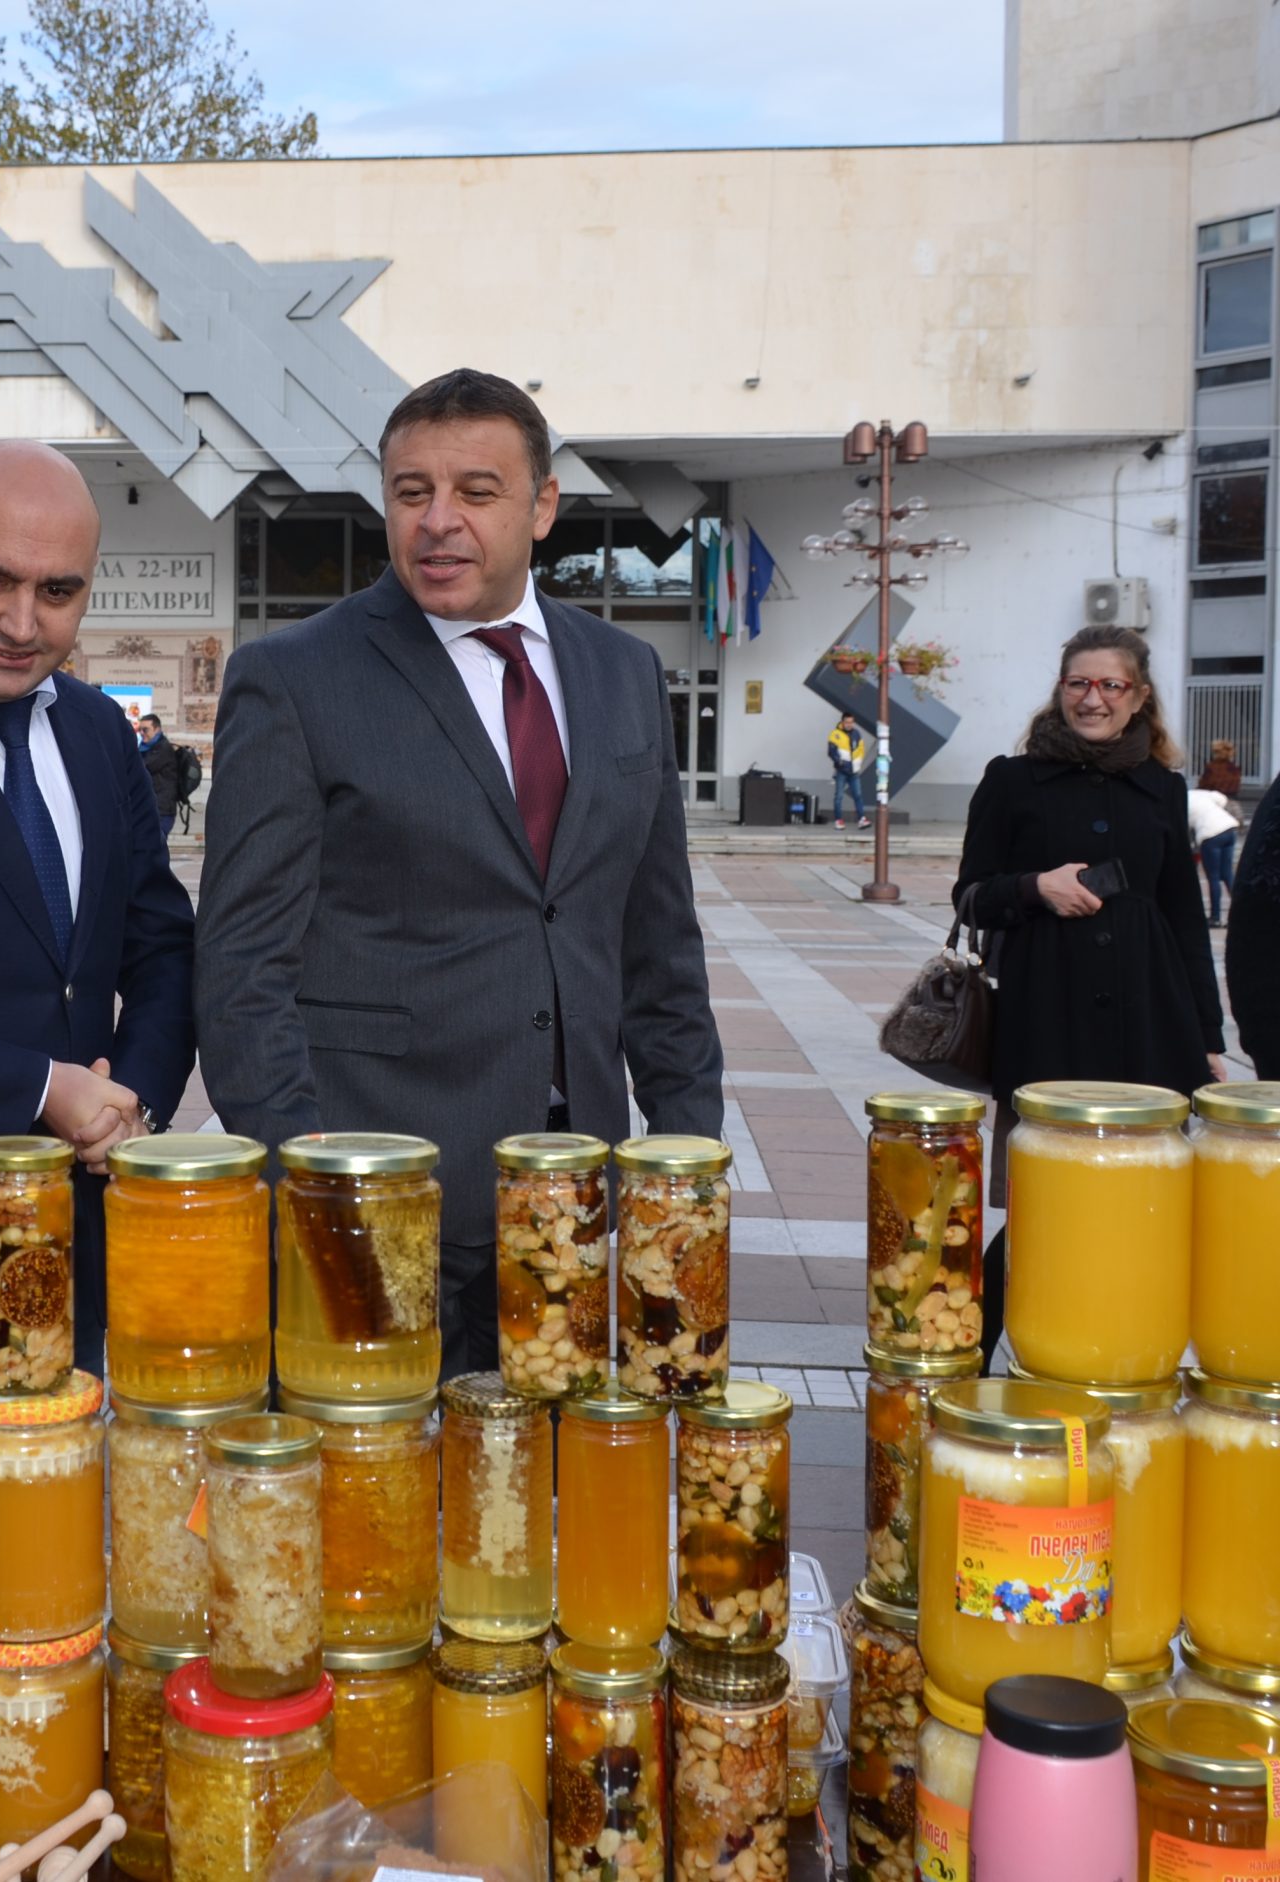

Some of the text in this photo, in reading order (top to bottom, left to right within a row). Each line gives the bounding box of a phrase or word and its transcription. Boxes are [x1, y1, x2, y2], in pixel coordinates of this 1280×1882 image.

[94, 559, 202, 578] ЛА 22-РИ
[91, 591, 210, 610] ПТЕМВРИ
[1071, 1428, 1085, 1469] букет
[1030, 1535, 1088, 1557] пчелен
[926, 1820, 949, 1854] мед
